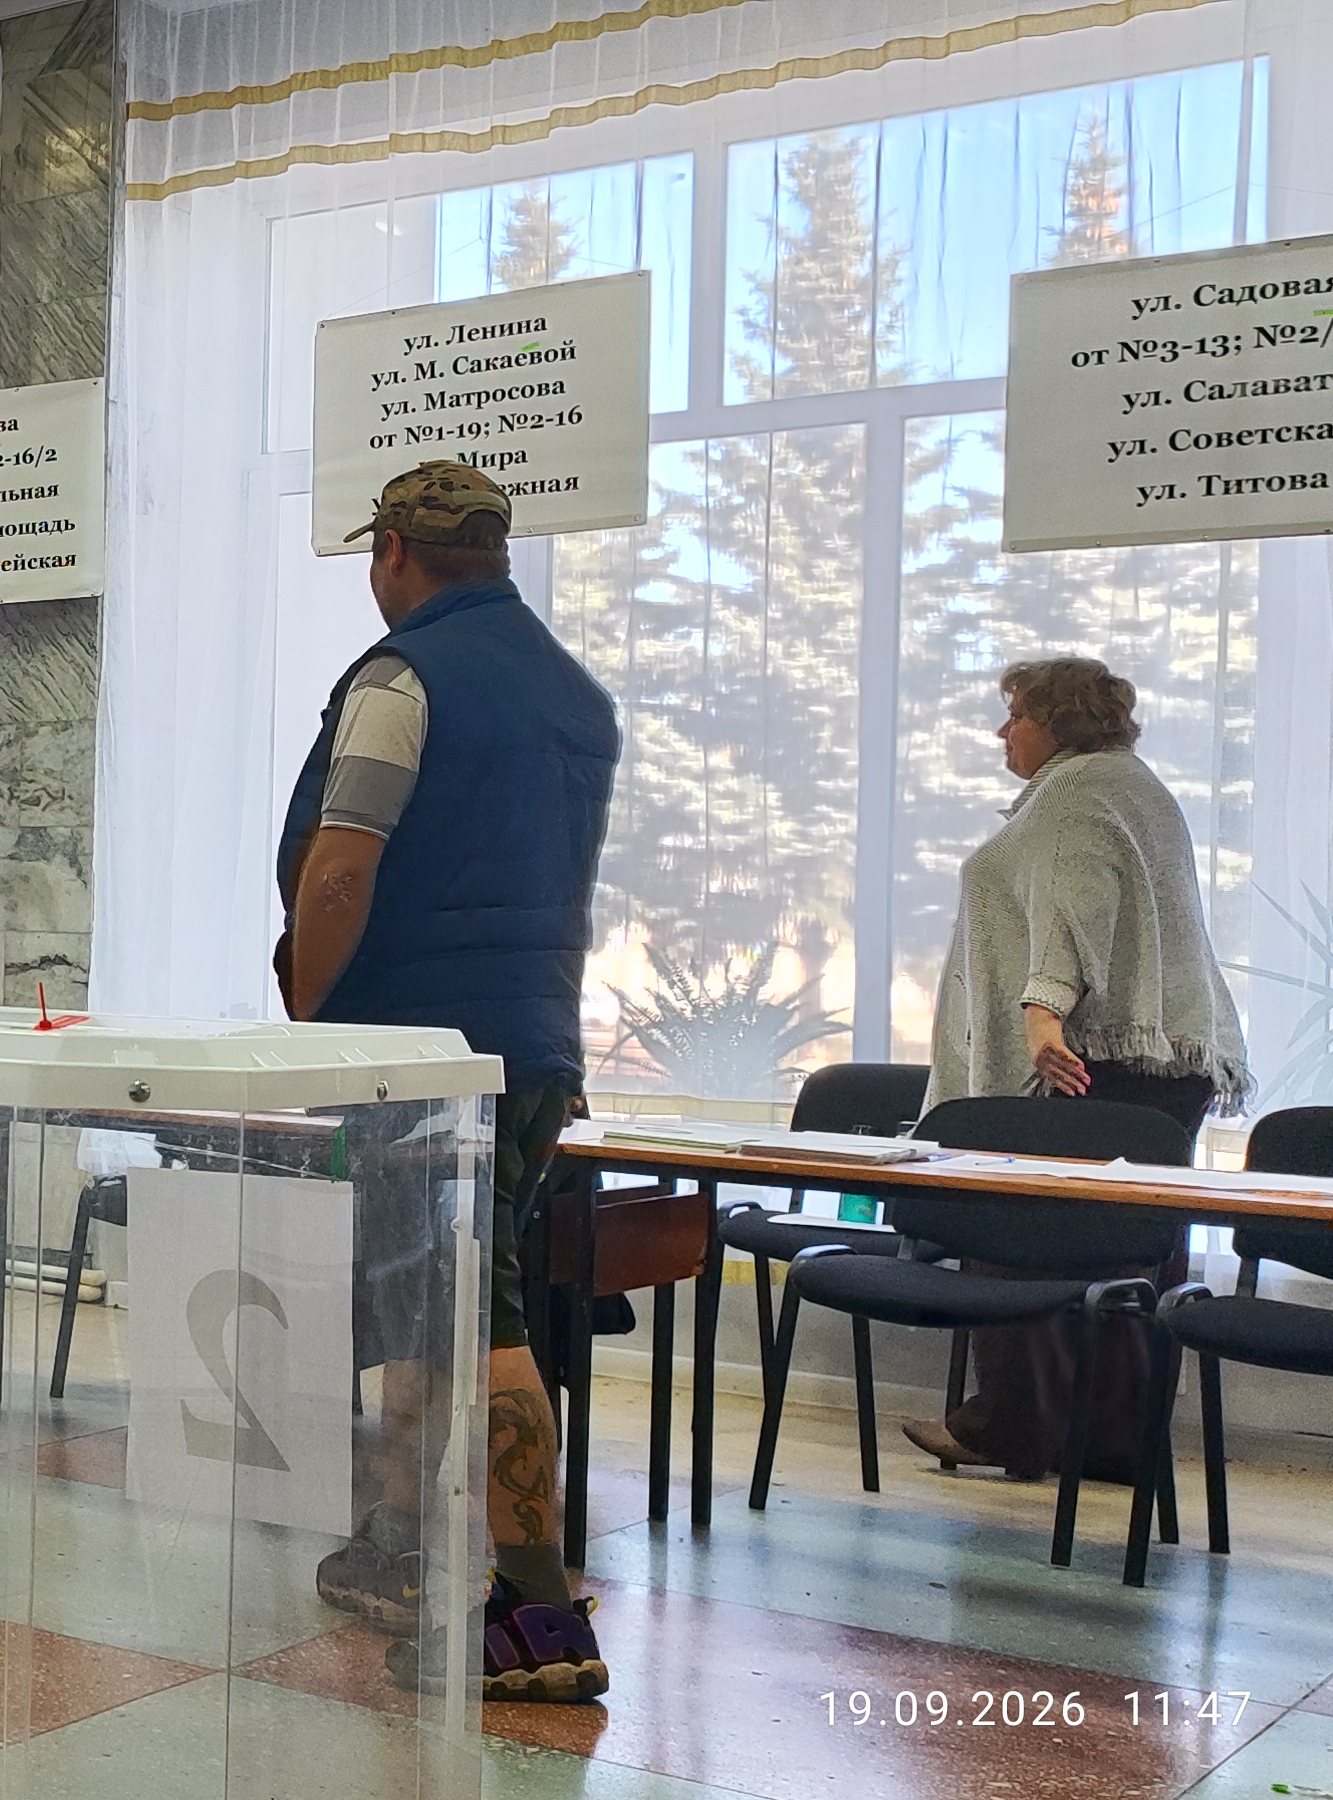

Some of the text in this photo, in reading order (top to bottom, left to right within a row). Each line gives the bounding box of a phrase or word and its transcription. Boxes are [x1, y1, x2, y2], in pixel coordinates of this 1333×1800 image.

[1131, 295, 1181, 320] ул.
[404, 318, 547, 356] ул. Ленина
[1072, 318, 1333, 367] от №3-13; №2/
[372, 339, 577, 391] ул. М. Сакаевой
[381, 381, 565, 421] ул. Матросова
[1122, 374, 1333, 415] ул. Салават
[370, 405, 582, 448] от №1-19; №2-16
[1107, 423, 1333, 463] ул. Советска
[1136, 473, 1329, 507] ул. Титова
